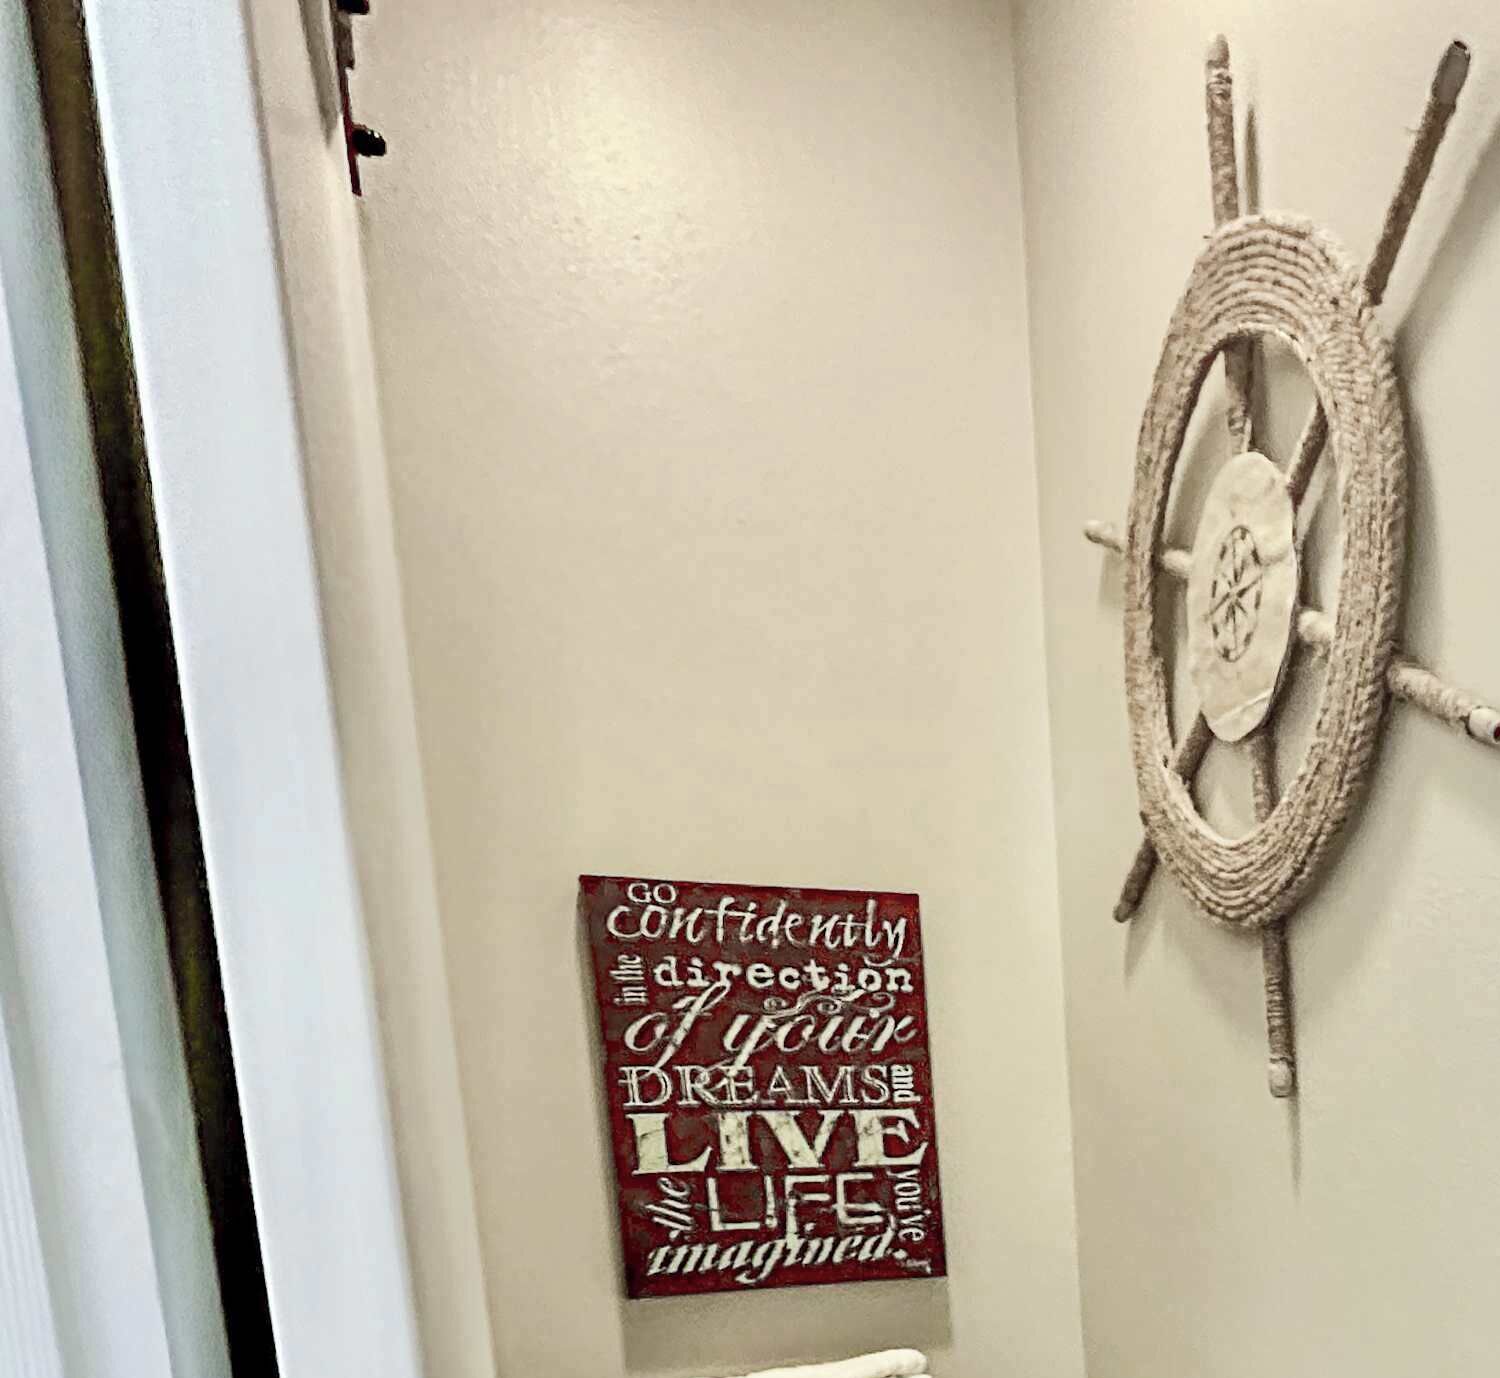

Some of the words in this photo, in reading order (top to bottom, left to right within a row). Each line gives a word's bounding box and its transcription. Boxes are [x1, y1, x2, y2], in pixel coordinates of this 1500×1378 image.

[626, 882, 677, 904] GO
[606, 896, 910, 967] confidently
[609, 954, 645, 981] the
[653, 955, 914, 992] direction
[613, 986, 647, 1005] in
[624, 980, 732, 1080] of
[706, 990, 917, 1080] your
[618, 1064, 890, 1106] DREAMS
[890, 1063, 921, 1103] and
[625, 1108, 929, 1175] LIVE
[643, 1177, 695, 1232] the
[707, 1172, 885, 1245] LIFE
[886, 1167, 932, 1242] you've
[646, 1214, 908, 1284] imagined.
